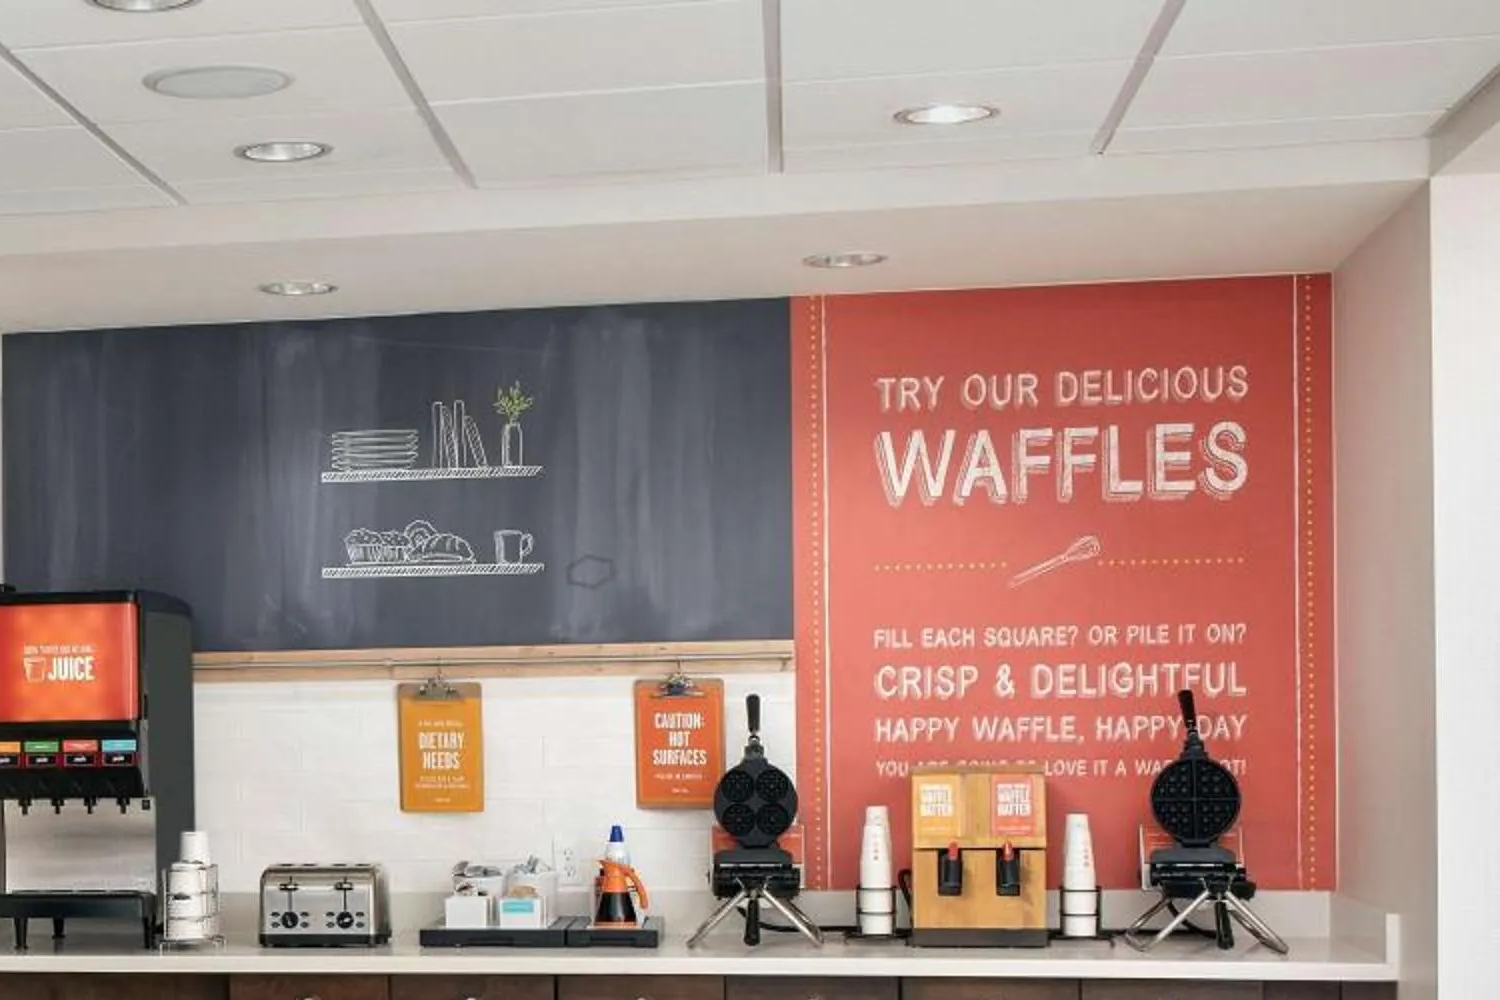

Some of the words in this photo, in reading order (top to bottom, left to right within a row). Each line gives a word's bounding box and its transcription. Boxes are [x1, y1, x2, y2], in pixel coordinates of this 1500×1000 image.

[876, 376, 944, 412] TRY
[960, 373, 1039, 410] OUR
[1056, 365, 1249, 406] DELICIOUS
[874, 421, 1249, 508] WAFFLES
[874, 628, 913, 649] FILL
[921, 627, 975, 648] EACH
[984, 625, 1078, 648] SQUARE?
[1088, 625, 1118, 646] OR
[1127, 624, 1170, 645] PILE
[1178, 624, 1196, 645] IT
[1206, 623, 1247, 644] ON?
[47, 655, 96, 681] JUICE
[874, 664, 979, 699] CRISP
[996, 663, 1016, 697] &
[1031, 661, 1248, 698] DELIGHTFUL
[654, 711, 705, 729] CAUTION:
[875, 716, 960, 744] HAPPY
[972, 715, 1085, 745] WAFFLE,
[1096, 714, 1184, 743] HAPPY
[1197, 714, 1248, 742] DAY
[668, 731, 692, 747] HOT
[423, 752, 461, 768] NEEDS
[653, 749, 708, 766] SURFACES
[876, 760, 910, 777] YOU
[1044, 759, 1088, 777] LOVE
[1093, 759, 1109, 776] IT
[1114, 759, 1127, 776] A
